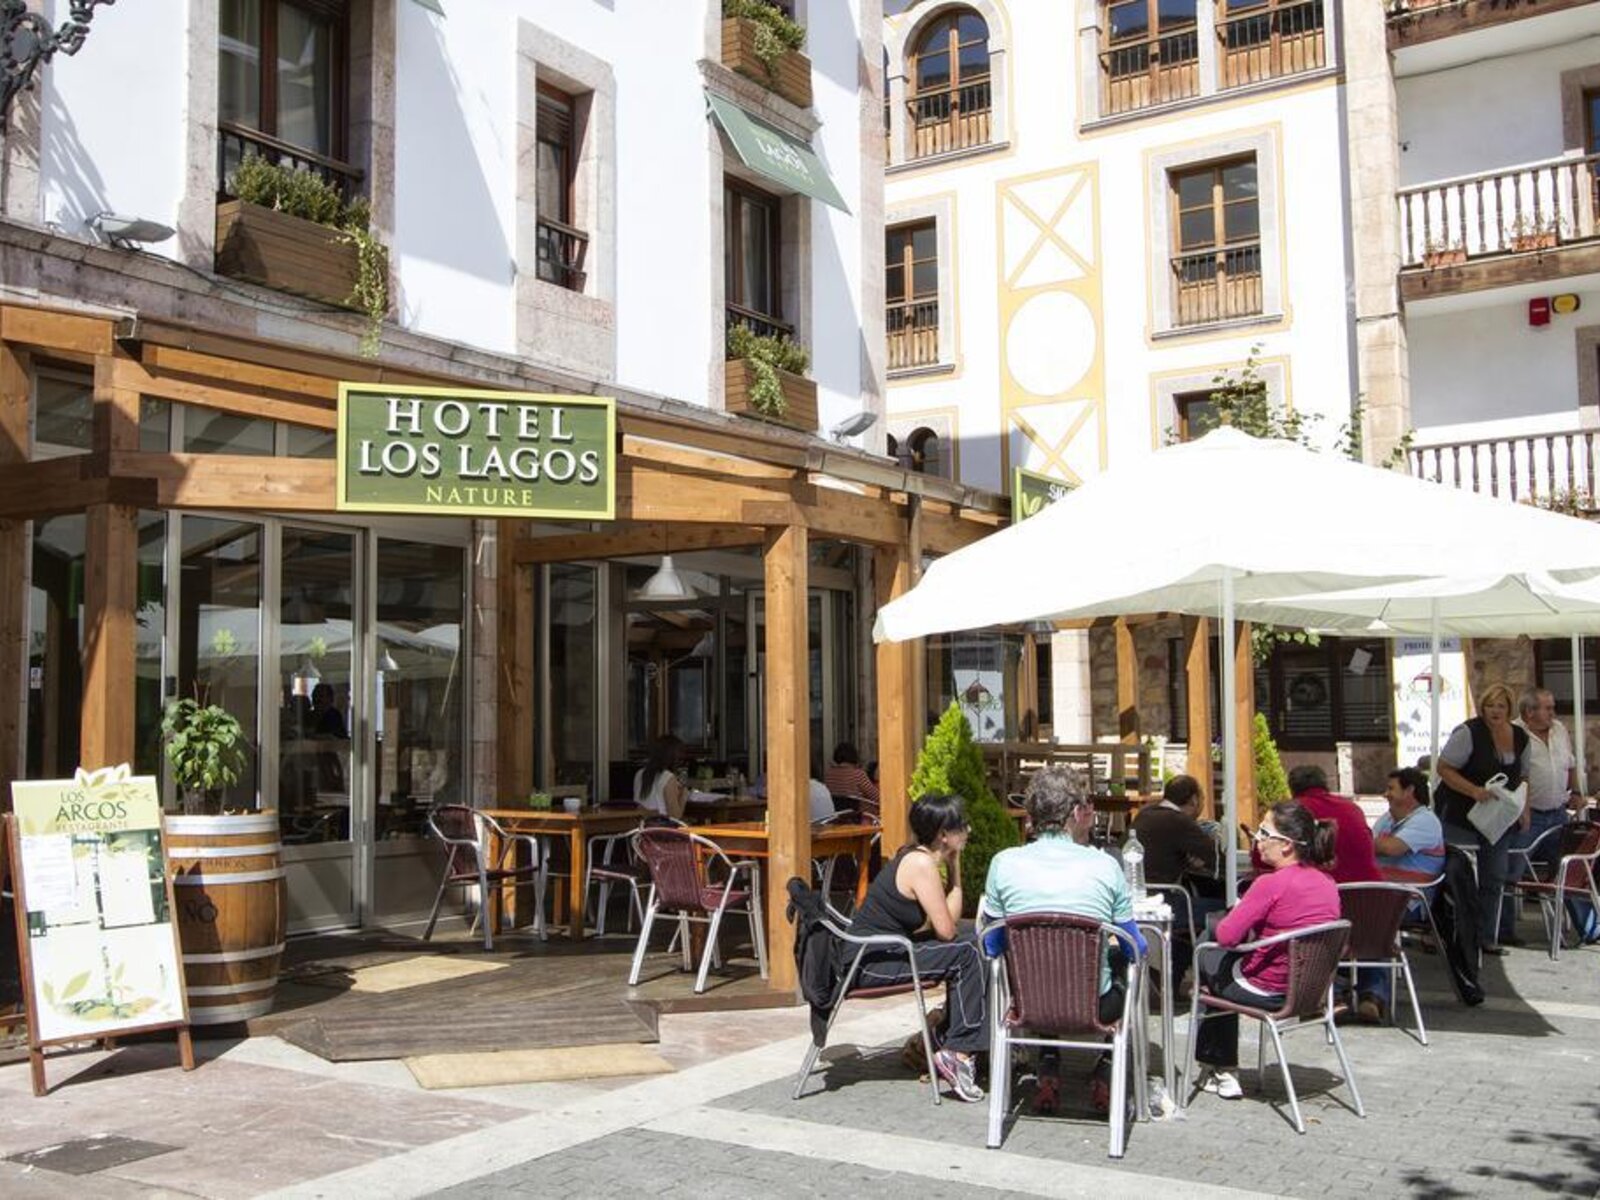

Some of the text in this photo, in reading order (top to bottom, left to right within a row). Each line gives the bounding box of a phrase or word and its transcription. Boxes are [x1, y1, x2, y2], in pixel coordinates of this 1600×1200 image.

[385, 399, 573, 441] HOTEL
[360, 440, 599, 483] LOS LAGOS
[425, 486, 533, 506] NATURE
[60, 791, 85, 803] LOS
[55, 801, 127, 821] ARCOS
